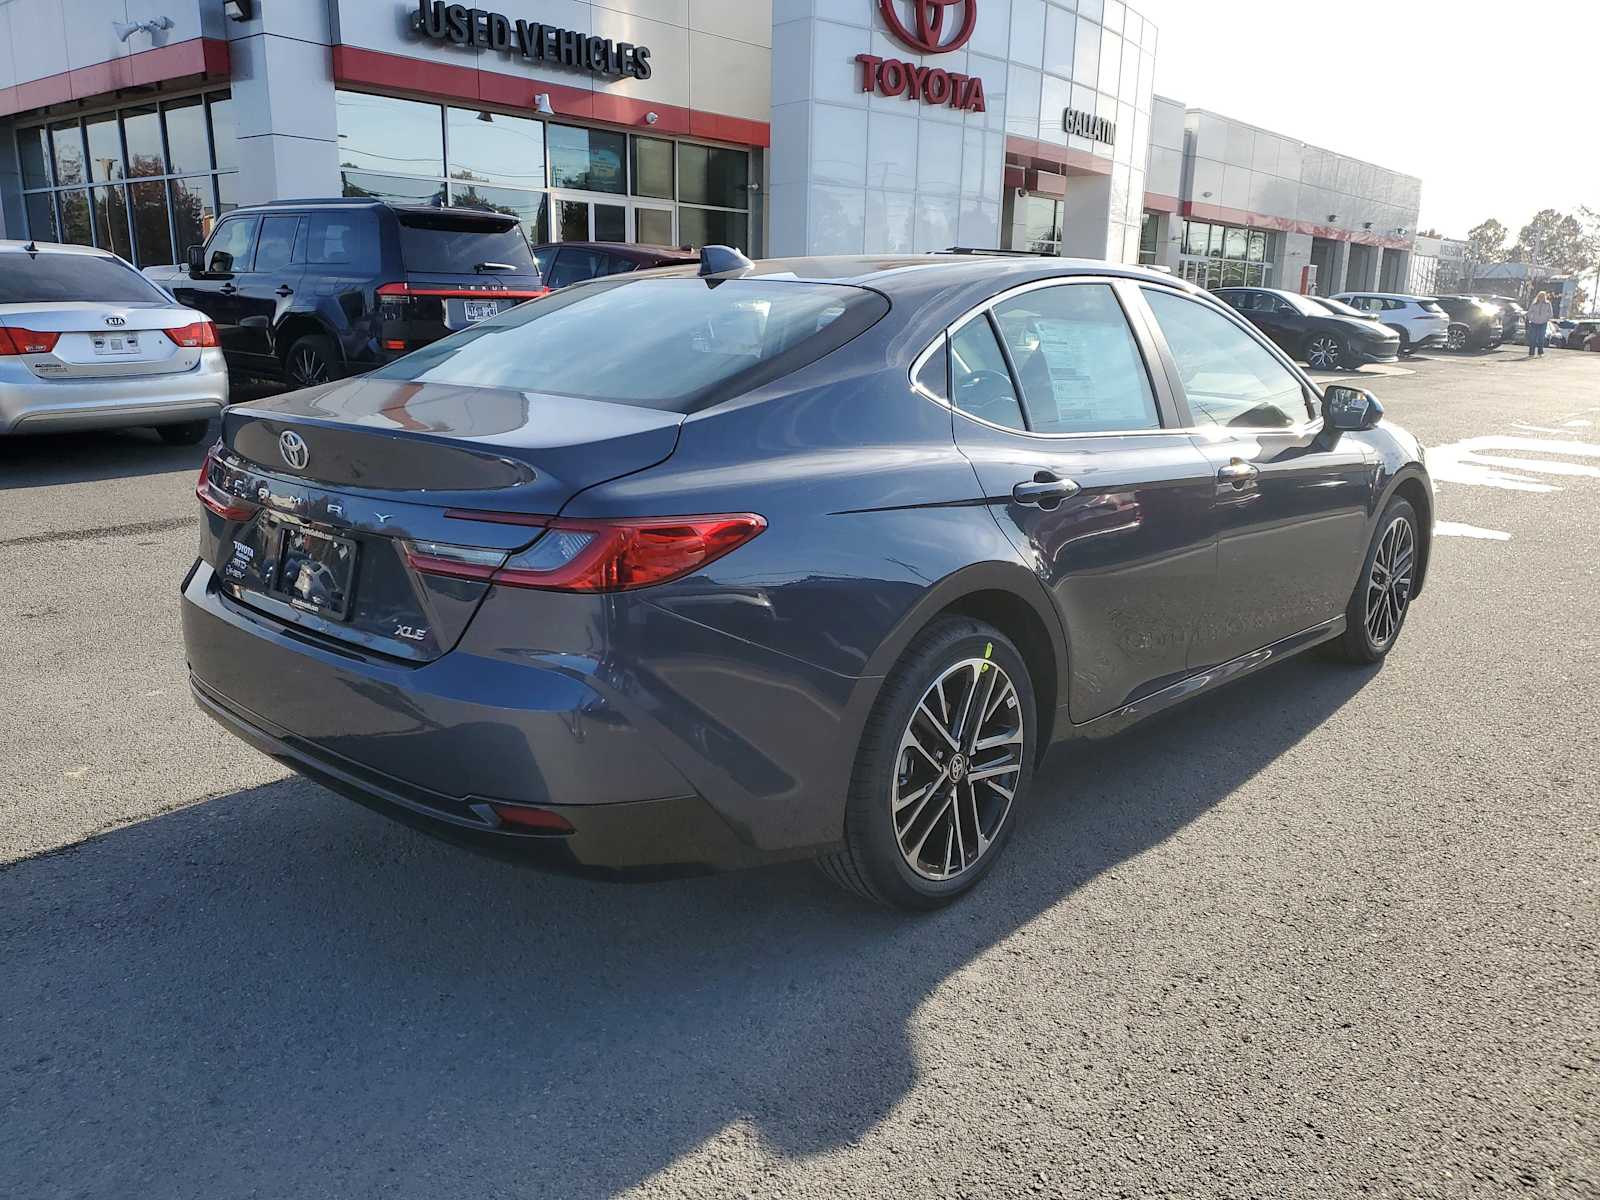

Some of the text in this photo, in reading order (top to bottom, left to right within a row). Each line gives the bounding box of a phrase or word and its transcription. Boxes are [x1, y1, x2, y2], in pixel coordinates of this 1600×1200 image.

[419, 0, 652, 80] USED VEHICLES
[856, 54, 985, 112] TOYOTA
[1062, 106, 1118, 146] GALLATIN
[108, 317, 126, 326] KIA
[233, 540, 254, 558] TOYOTA
[394, 624, 427, 641] XLE
